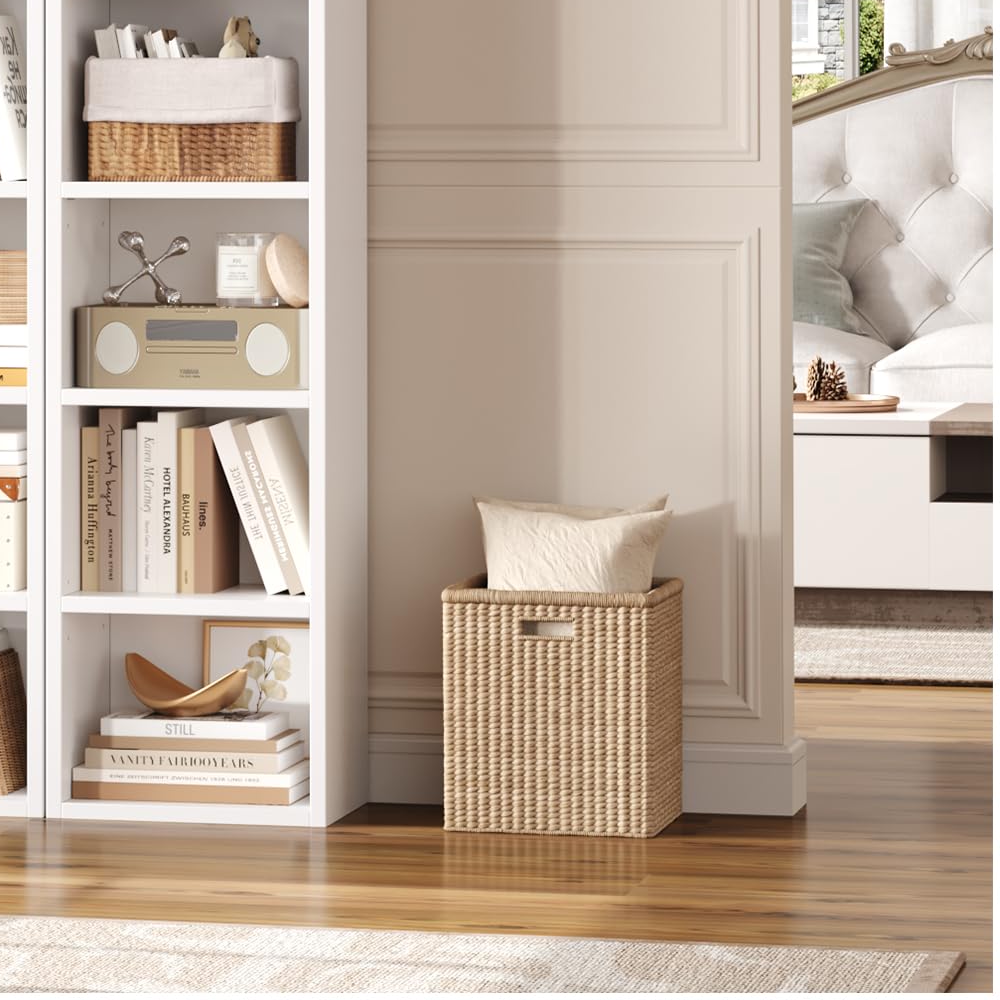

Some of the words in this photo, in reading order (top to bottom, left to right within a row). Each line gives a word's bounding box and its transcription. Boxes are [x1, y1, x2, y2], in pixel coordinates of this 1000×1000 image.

[105, 424, 116, 447] The
[144, 436, 154, 463] Karen
[87, 457, 99, 499] Arianna
[139, 464, 155, 513] McCartney
[163, 467, 171, 496] HOTEL
[163, 499, 171, 554] ALEXANDRA
[182, 493, 190, 537] BAUHAUS
[199, 501, 208, 530] lines.
[84, 503, 99, 563] Huffington
[164, 723, 195, 736] STILL
[110, 754, 155, 766] VANITY
